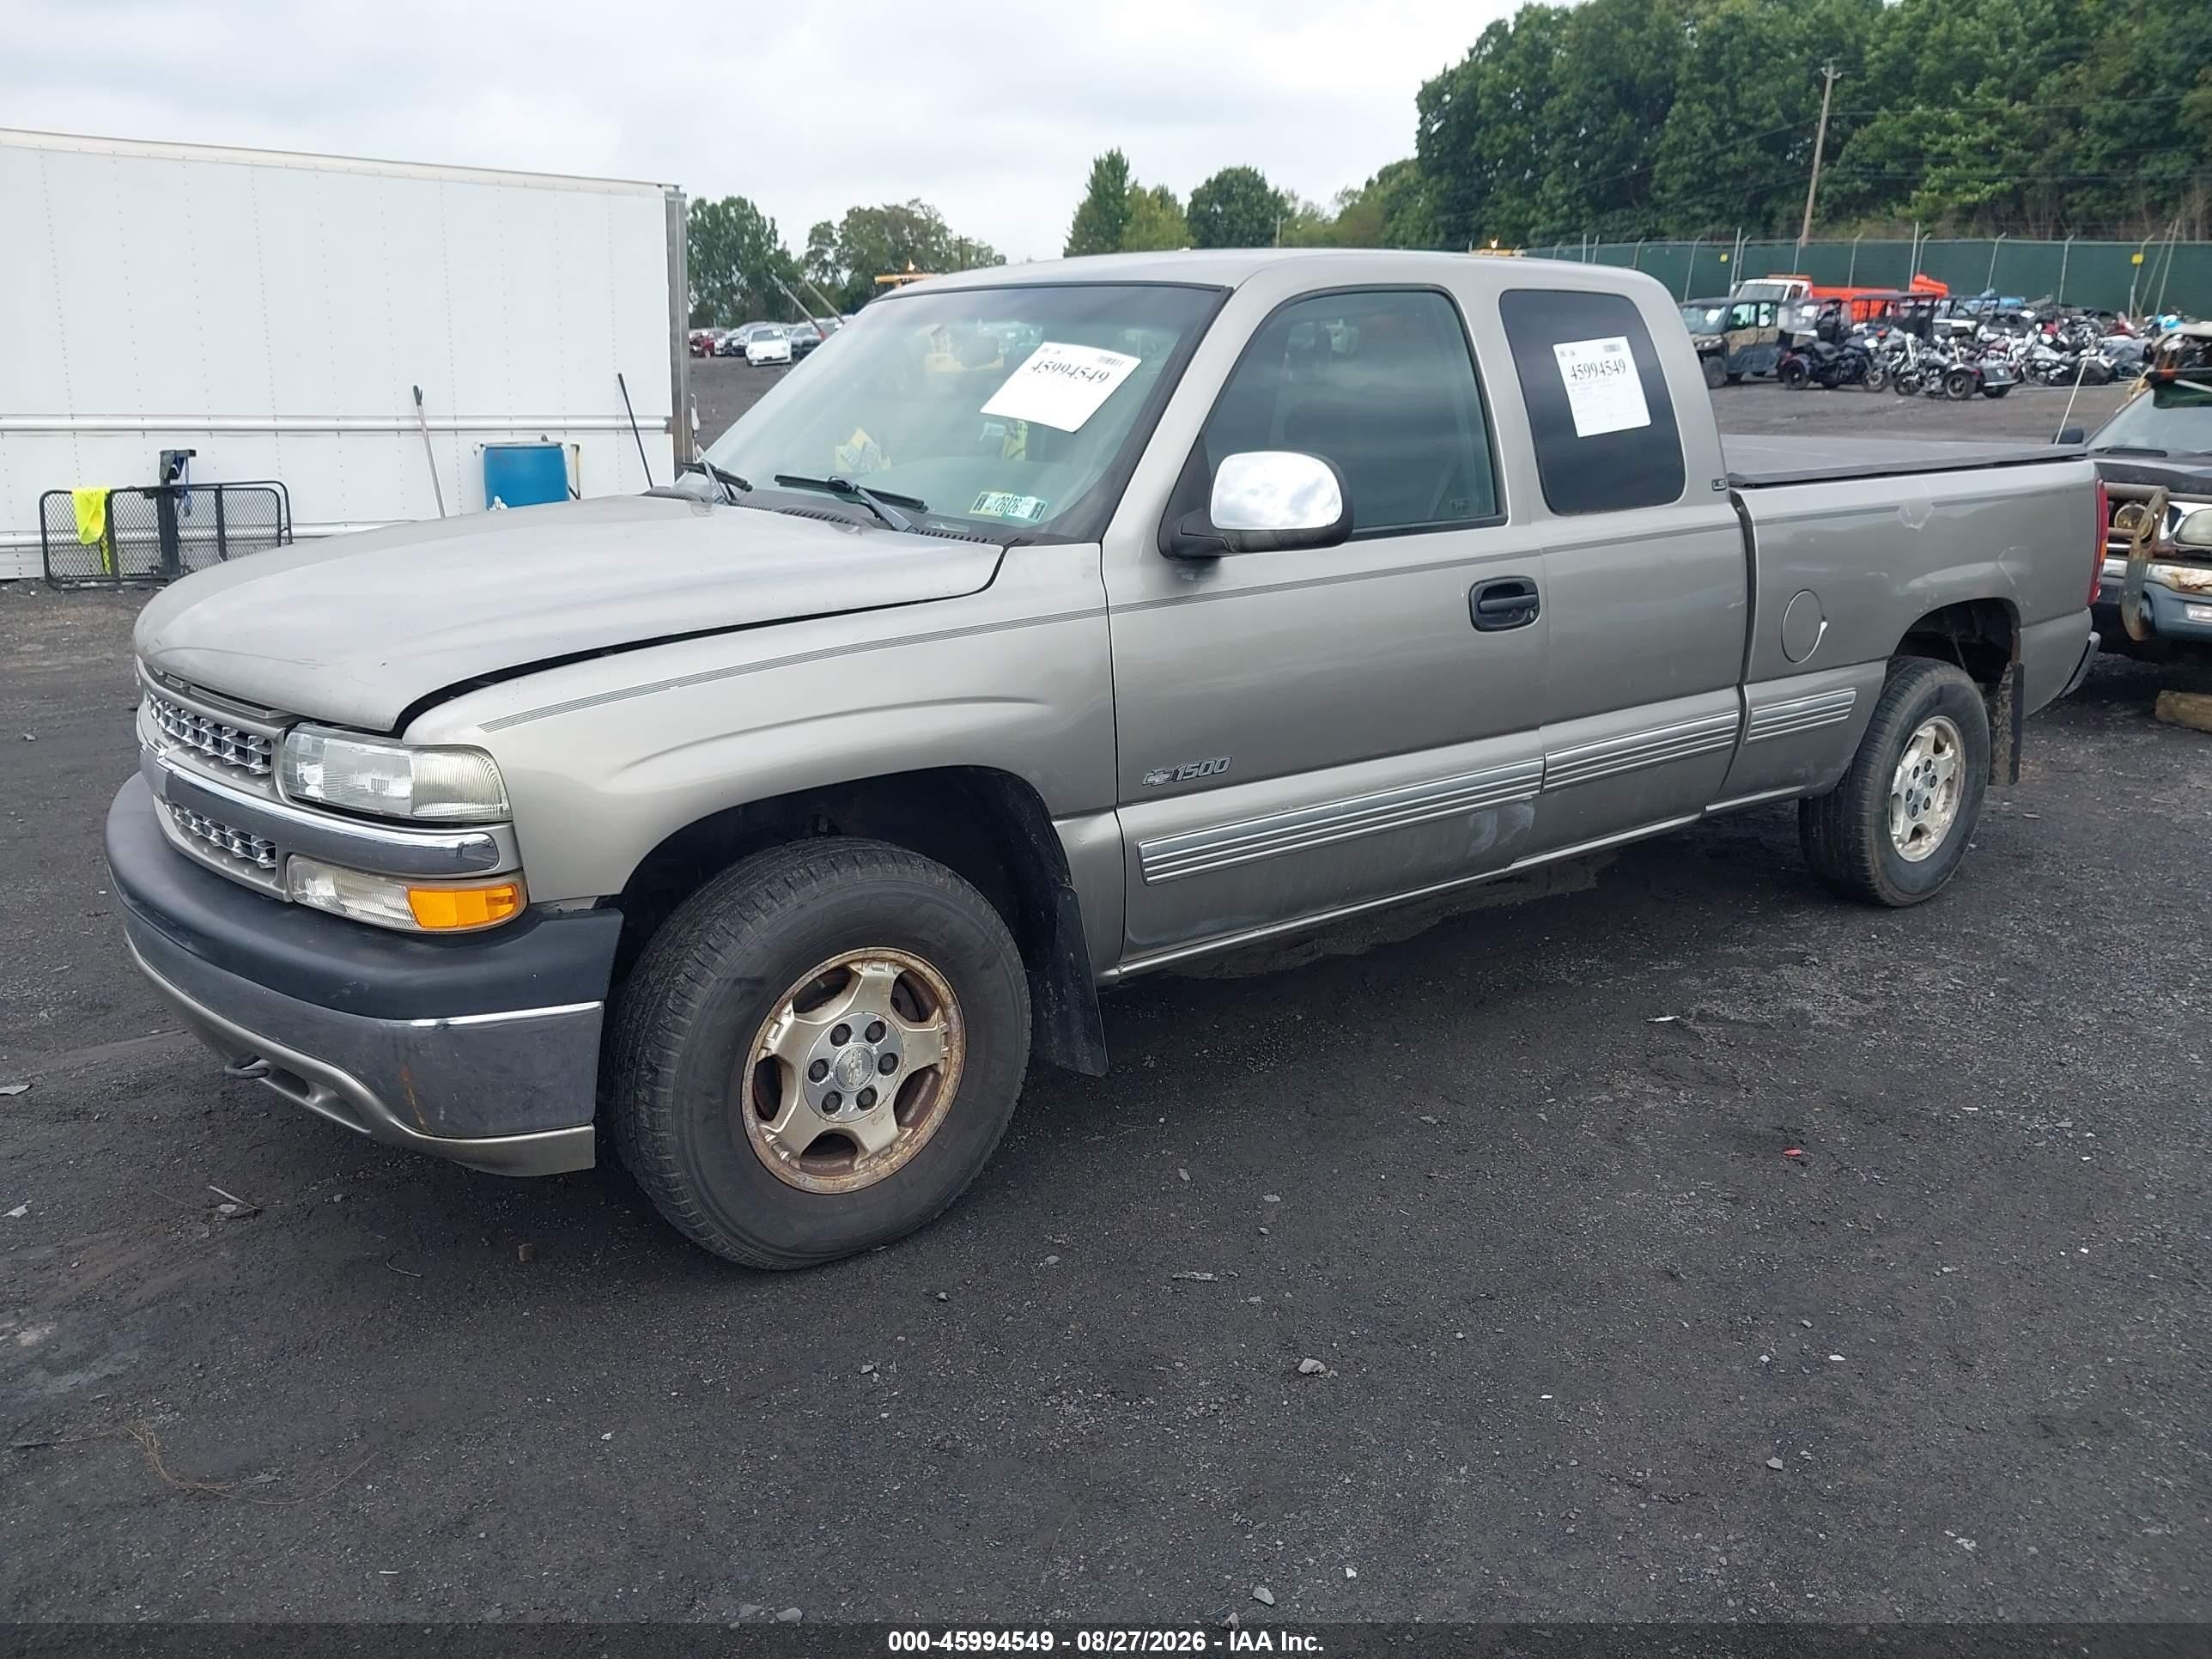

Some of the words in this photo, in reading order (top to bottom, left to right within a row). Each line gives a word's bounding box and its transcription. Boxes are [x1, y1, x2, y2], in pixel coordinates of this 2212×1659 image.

[1031, 360, 1110, 383] 45994549
[1571, 358, 1626, 380] 45994549
[1176, 757, 1231, 781] 1500
